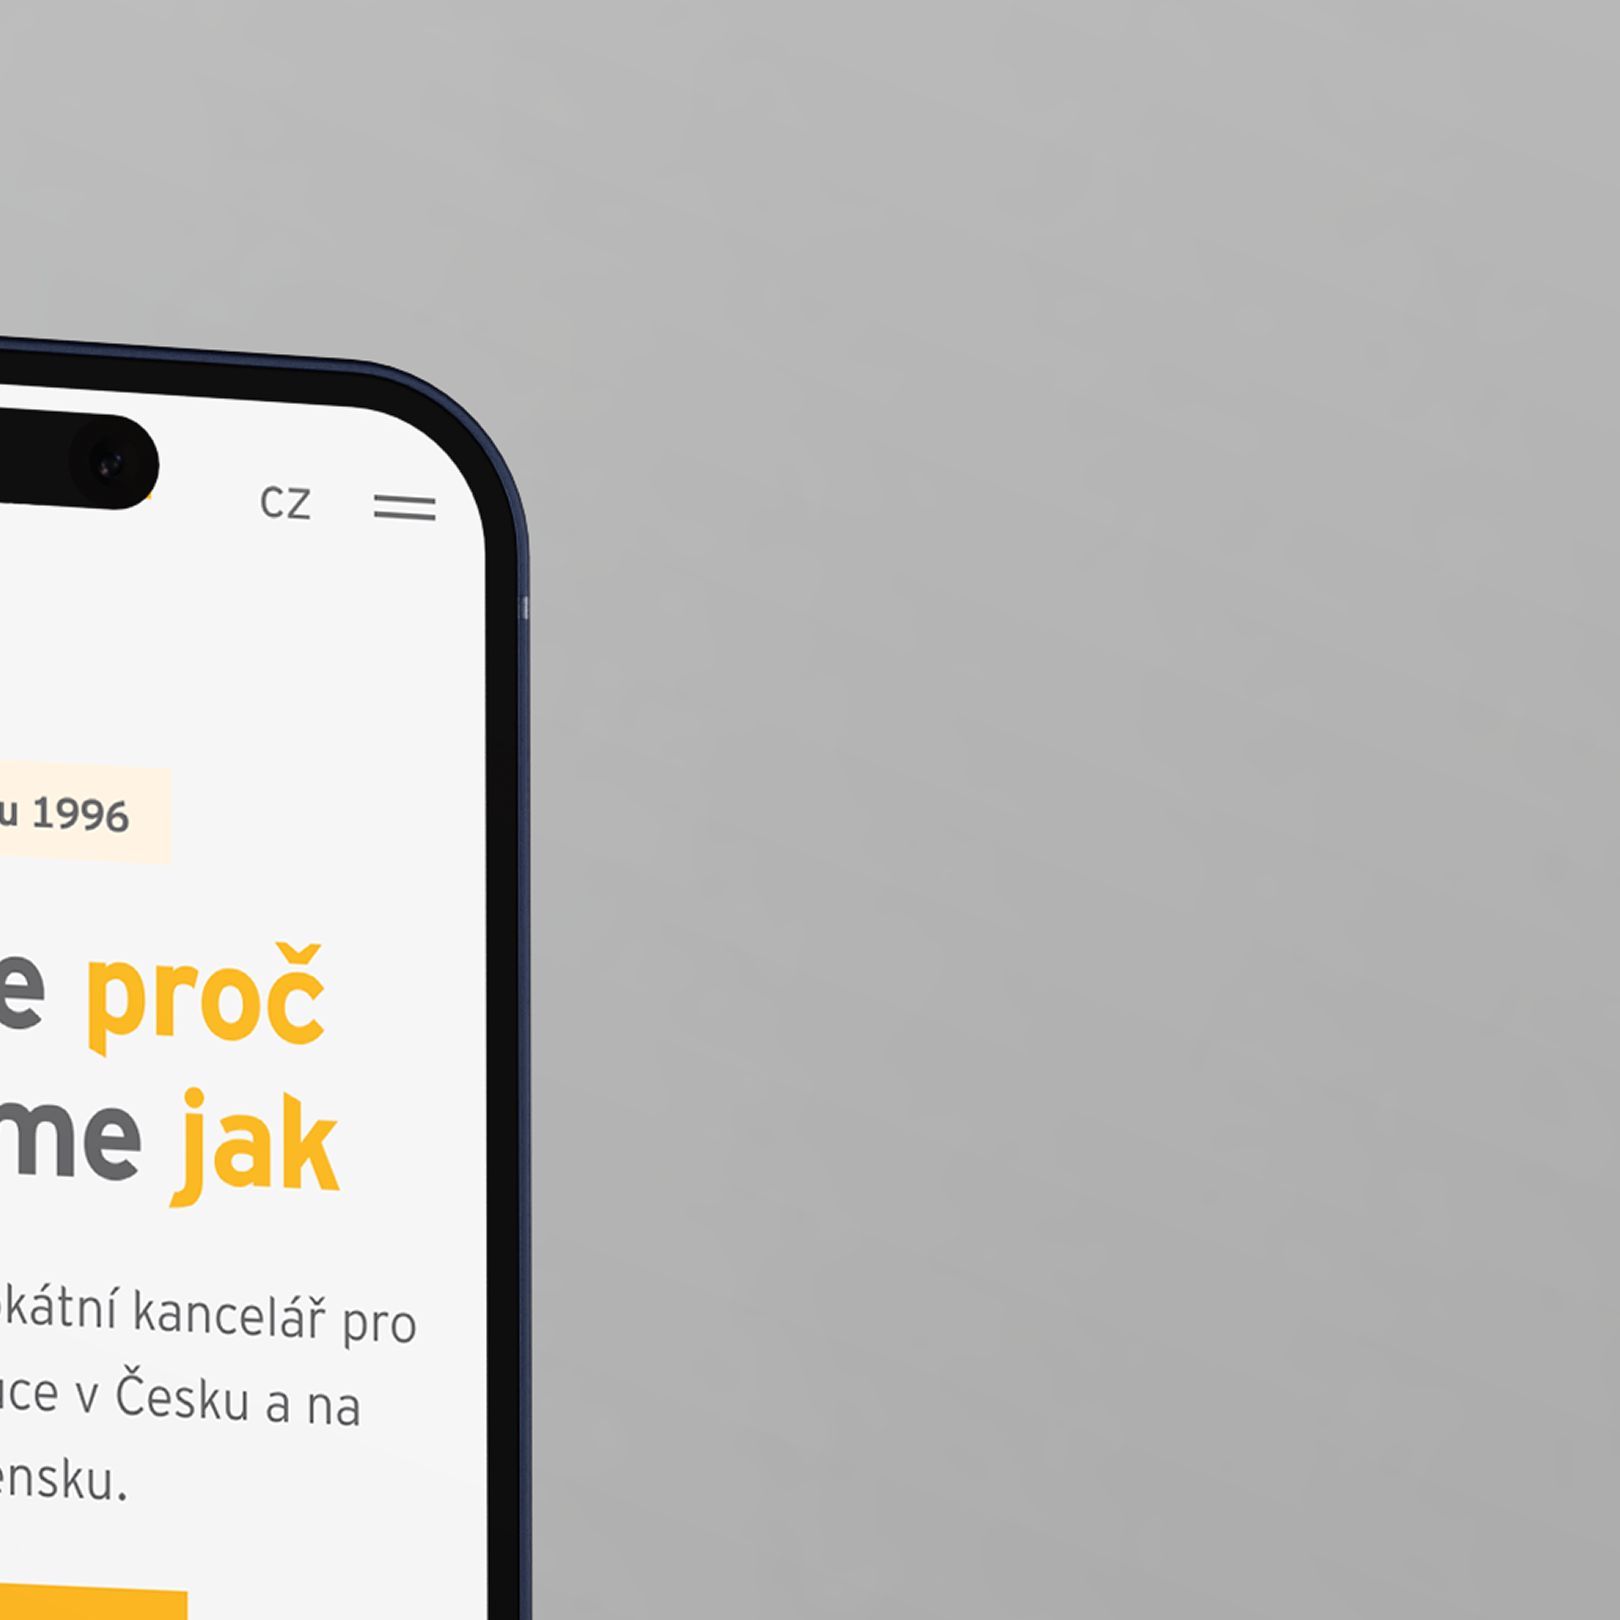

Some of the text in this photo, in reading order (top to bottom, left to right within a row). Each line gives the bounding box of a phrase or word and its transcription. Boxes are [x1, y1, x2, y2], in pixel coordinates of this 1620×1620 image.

[33, 796, 130, 833] 1996
[88, 941, 325, 1059] proč
[168, 1086, 341, 1209] jak
[134, 1289, 326, 1339] kancelář
[344, 1310, 416, 1350] pro
[75, 1382, 99, 1414] v
[116, 1363, 248, 1421] Česku
[266, 1391, 289, 1423] a
[309, 1393, 360, 1427] na
